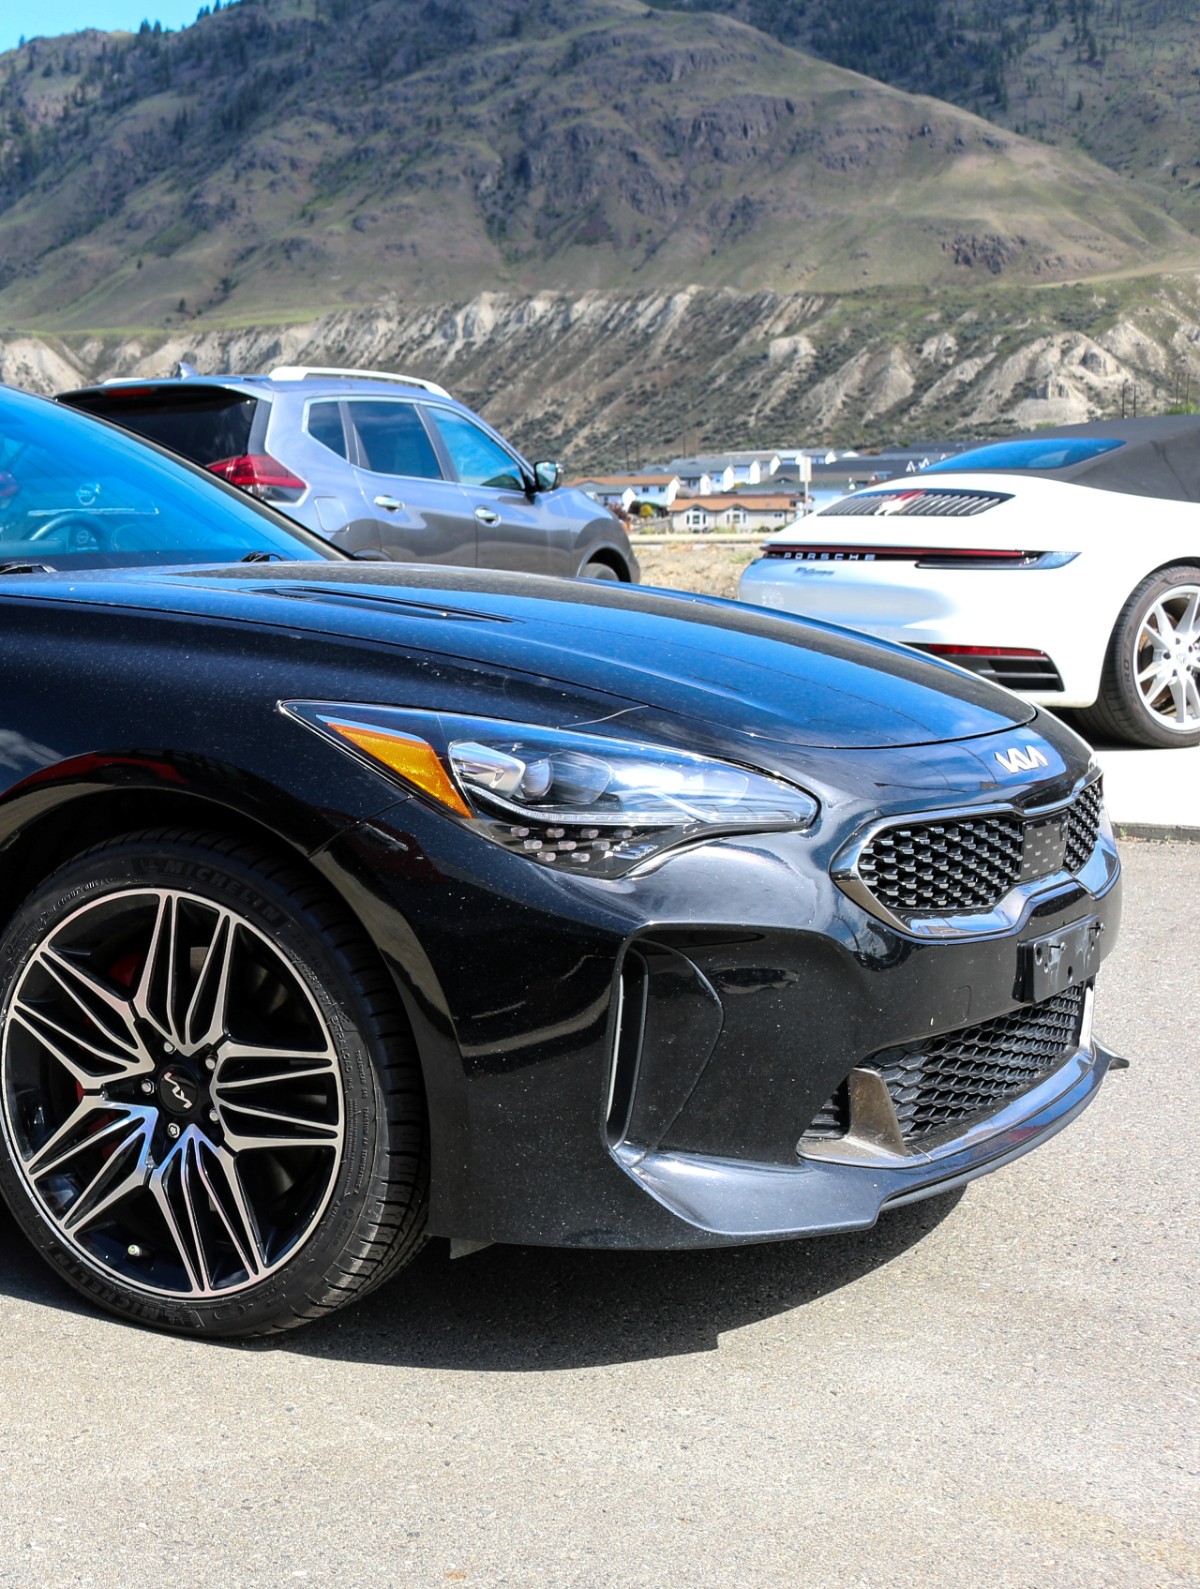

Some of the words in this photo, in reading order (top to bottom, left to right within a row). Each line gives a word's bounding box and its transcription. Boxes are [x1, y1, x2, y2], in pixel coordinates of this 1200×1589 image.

[783, 552, 876, 561] PORSCHE
[165, 859, 280, 921] MICHELIN
[55, 1251, 159, 1319] MICHELIN
